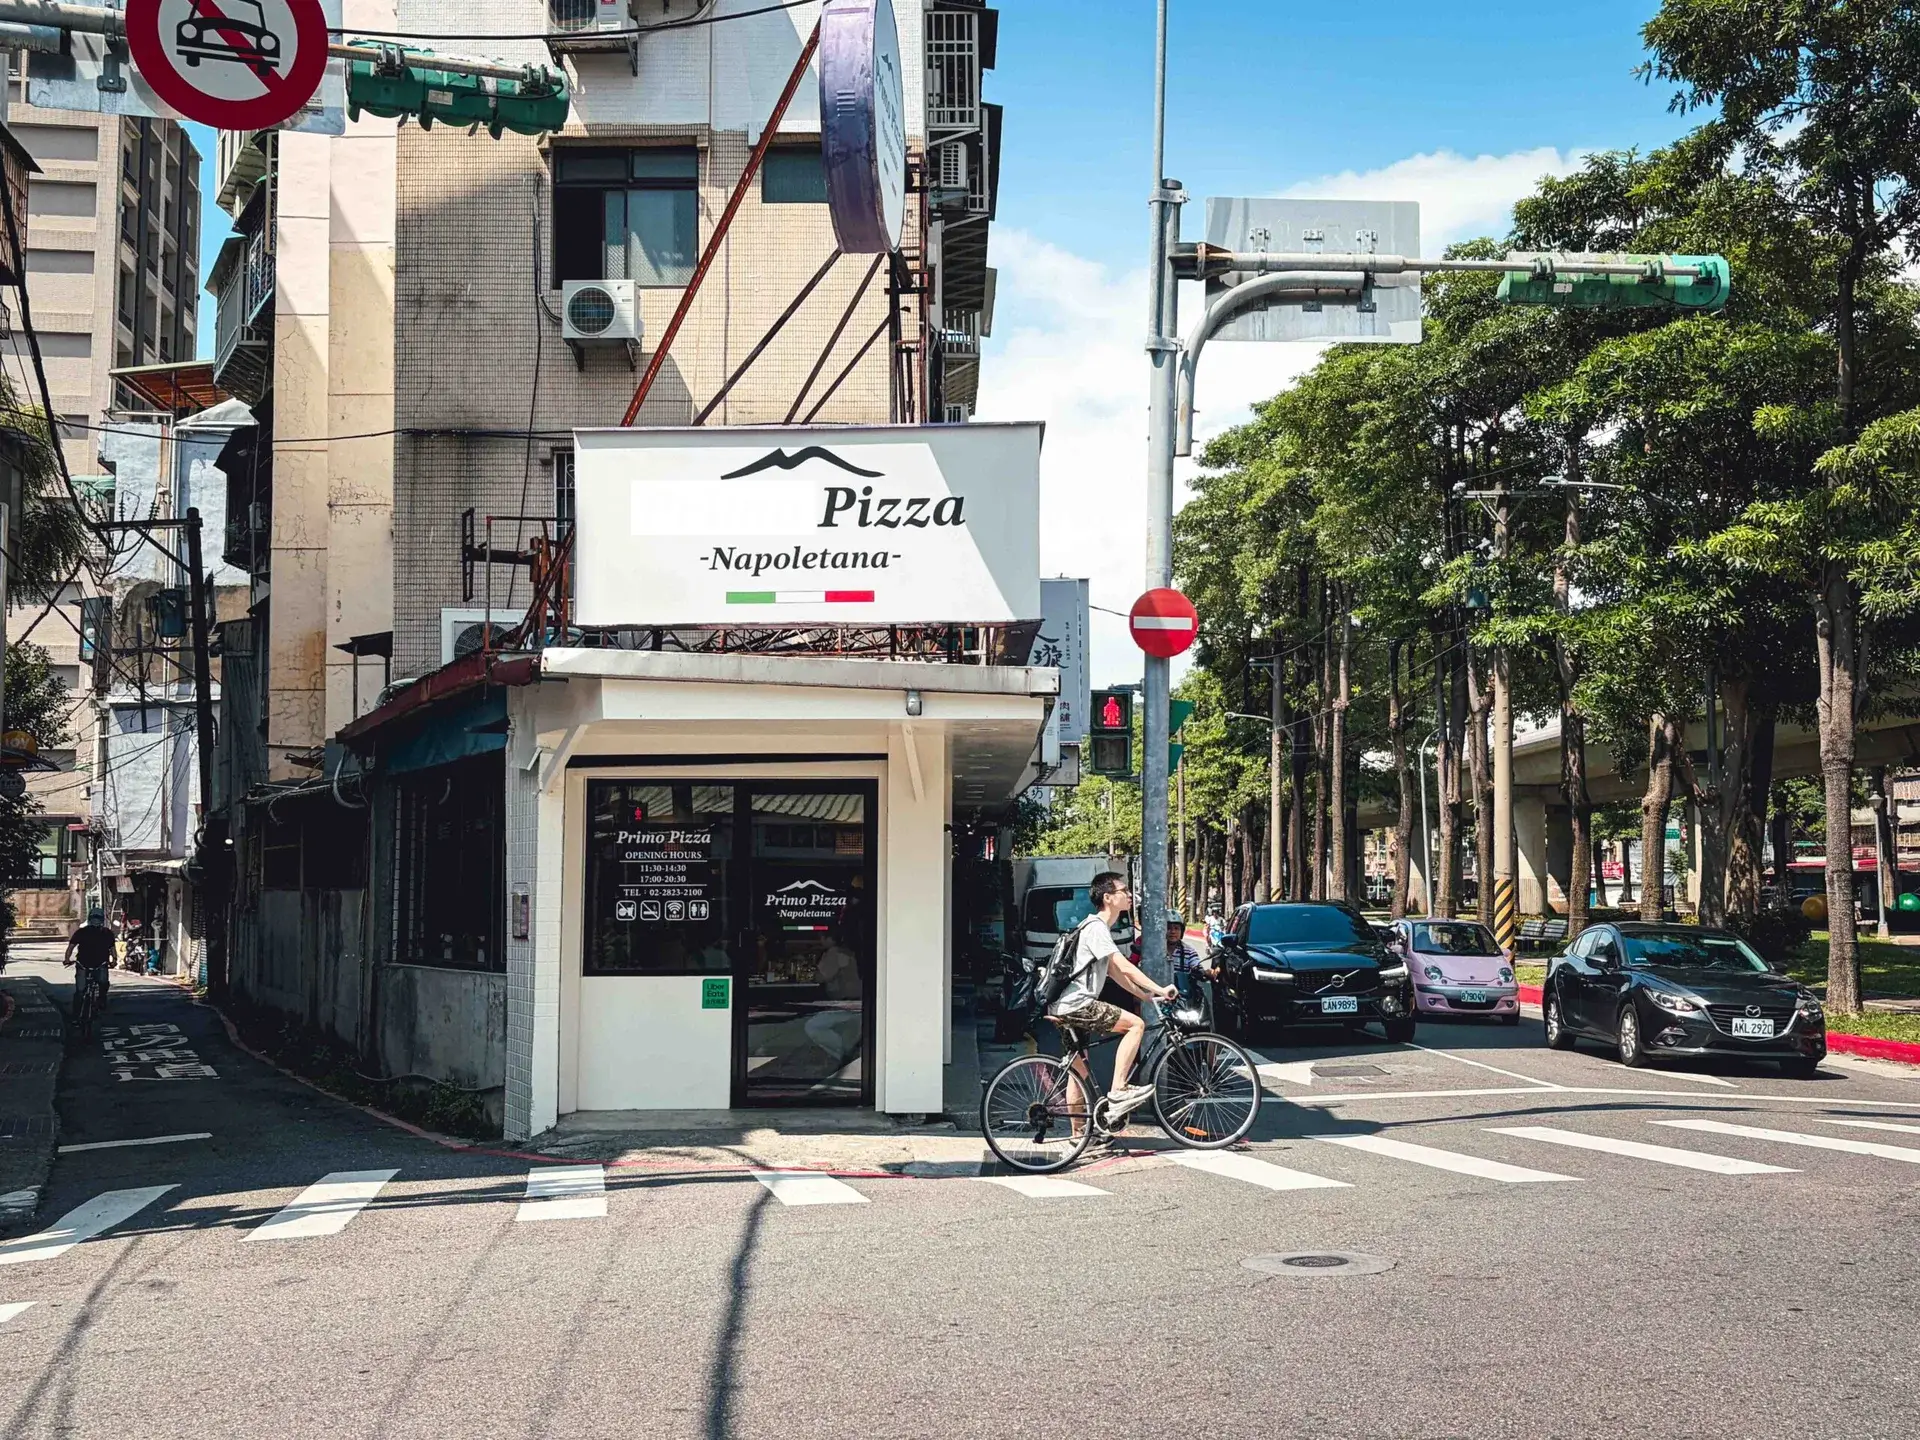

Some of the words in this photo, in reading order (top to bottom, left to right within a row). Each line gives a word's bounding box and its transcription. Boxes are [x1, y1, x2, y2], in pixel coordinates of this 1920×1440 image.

[816, 485, 966, 530] Pizza
[616, 830, 665, 844] Primo
[666, 830, 712, 844] Pizza
[625, 851, 668, 860] OPENING
[669, 851, 702, 860] HOURS
[639, 864, 687, 872] 11:30-14:30
[639, 875, 687, 883] 17:00-20:30
[649, 888, 703, 897] 02-2823-2100
[764, 894, 807, 906] Primo
[809, 894, 847, 906] Pizza
[706, 983, 725, 991] Uber
[706, 990, 725, 998] Eats
